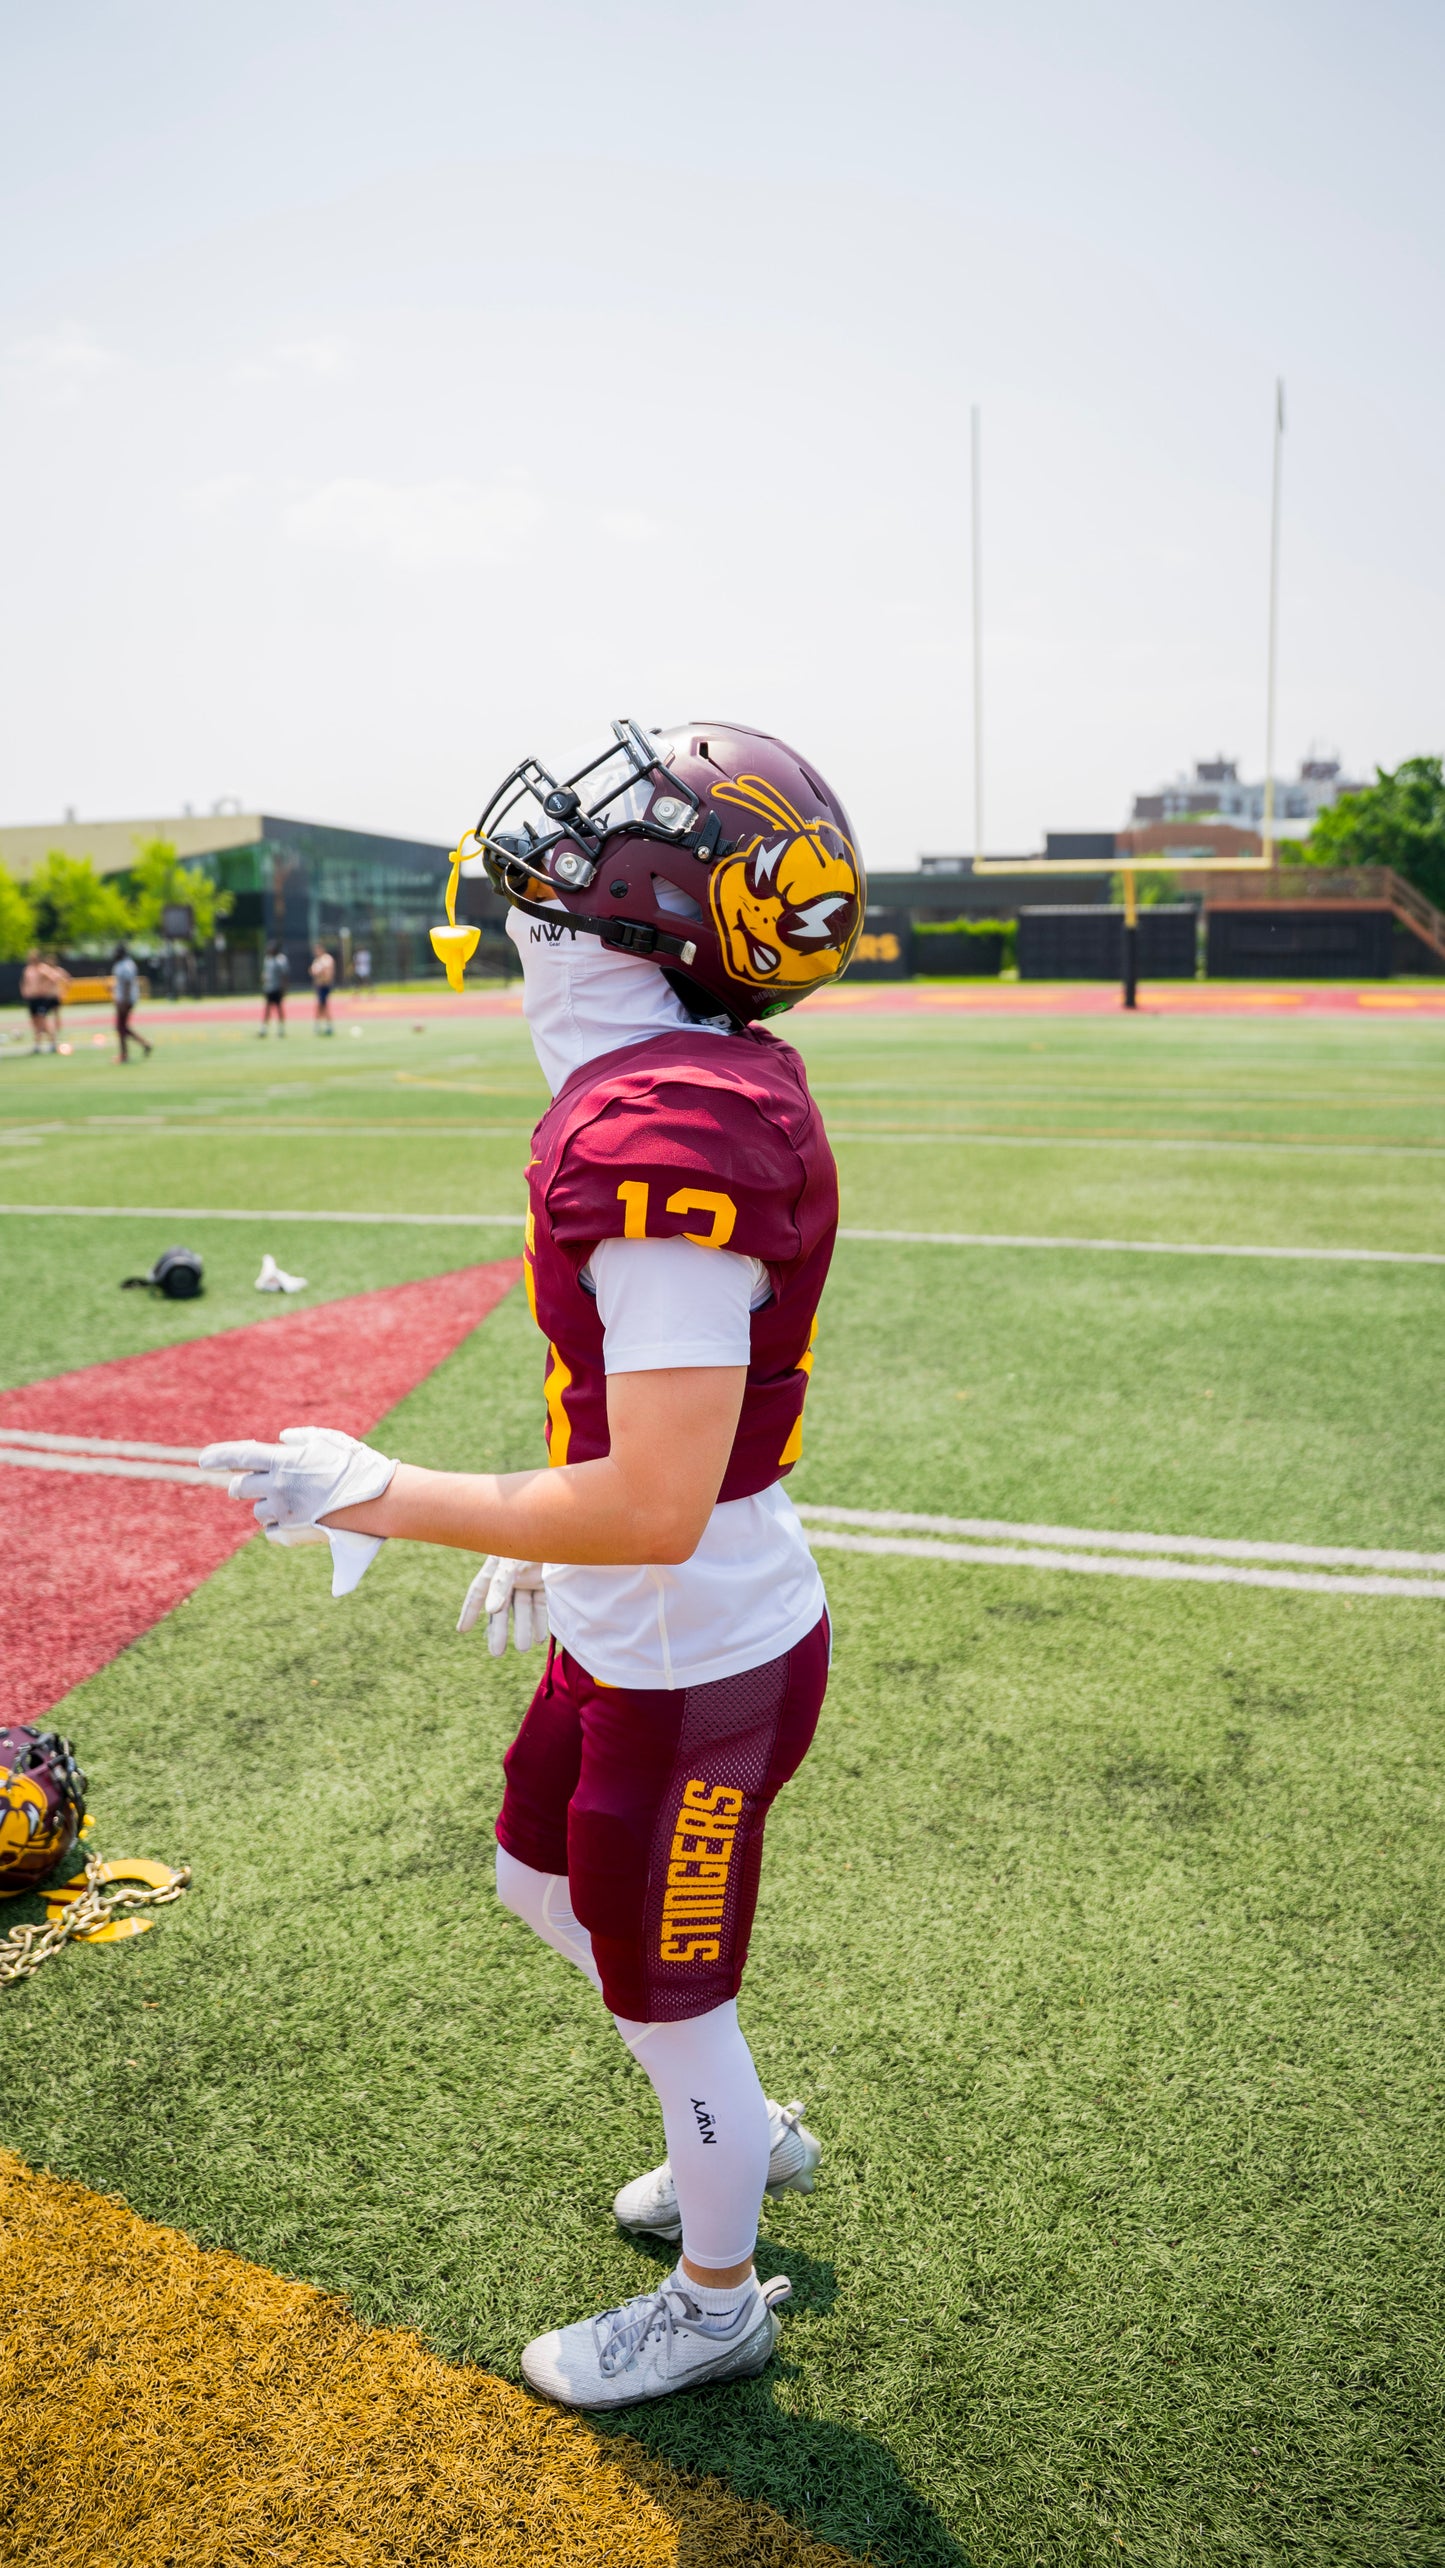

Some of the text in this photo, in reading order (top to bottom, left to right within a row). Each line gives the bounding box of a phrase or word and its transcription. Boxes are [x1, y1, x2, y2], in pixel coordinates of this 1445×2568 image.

[529, 923, 577, 943] NWY
[660, 1779, 744, 1962] STINGERS
[690, 2097, 717, 2144] NWY
